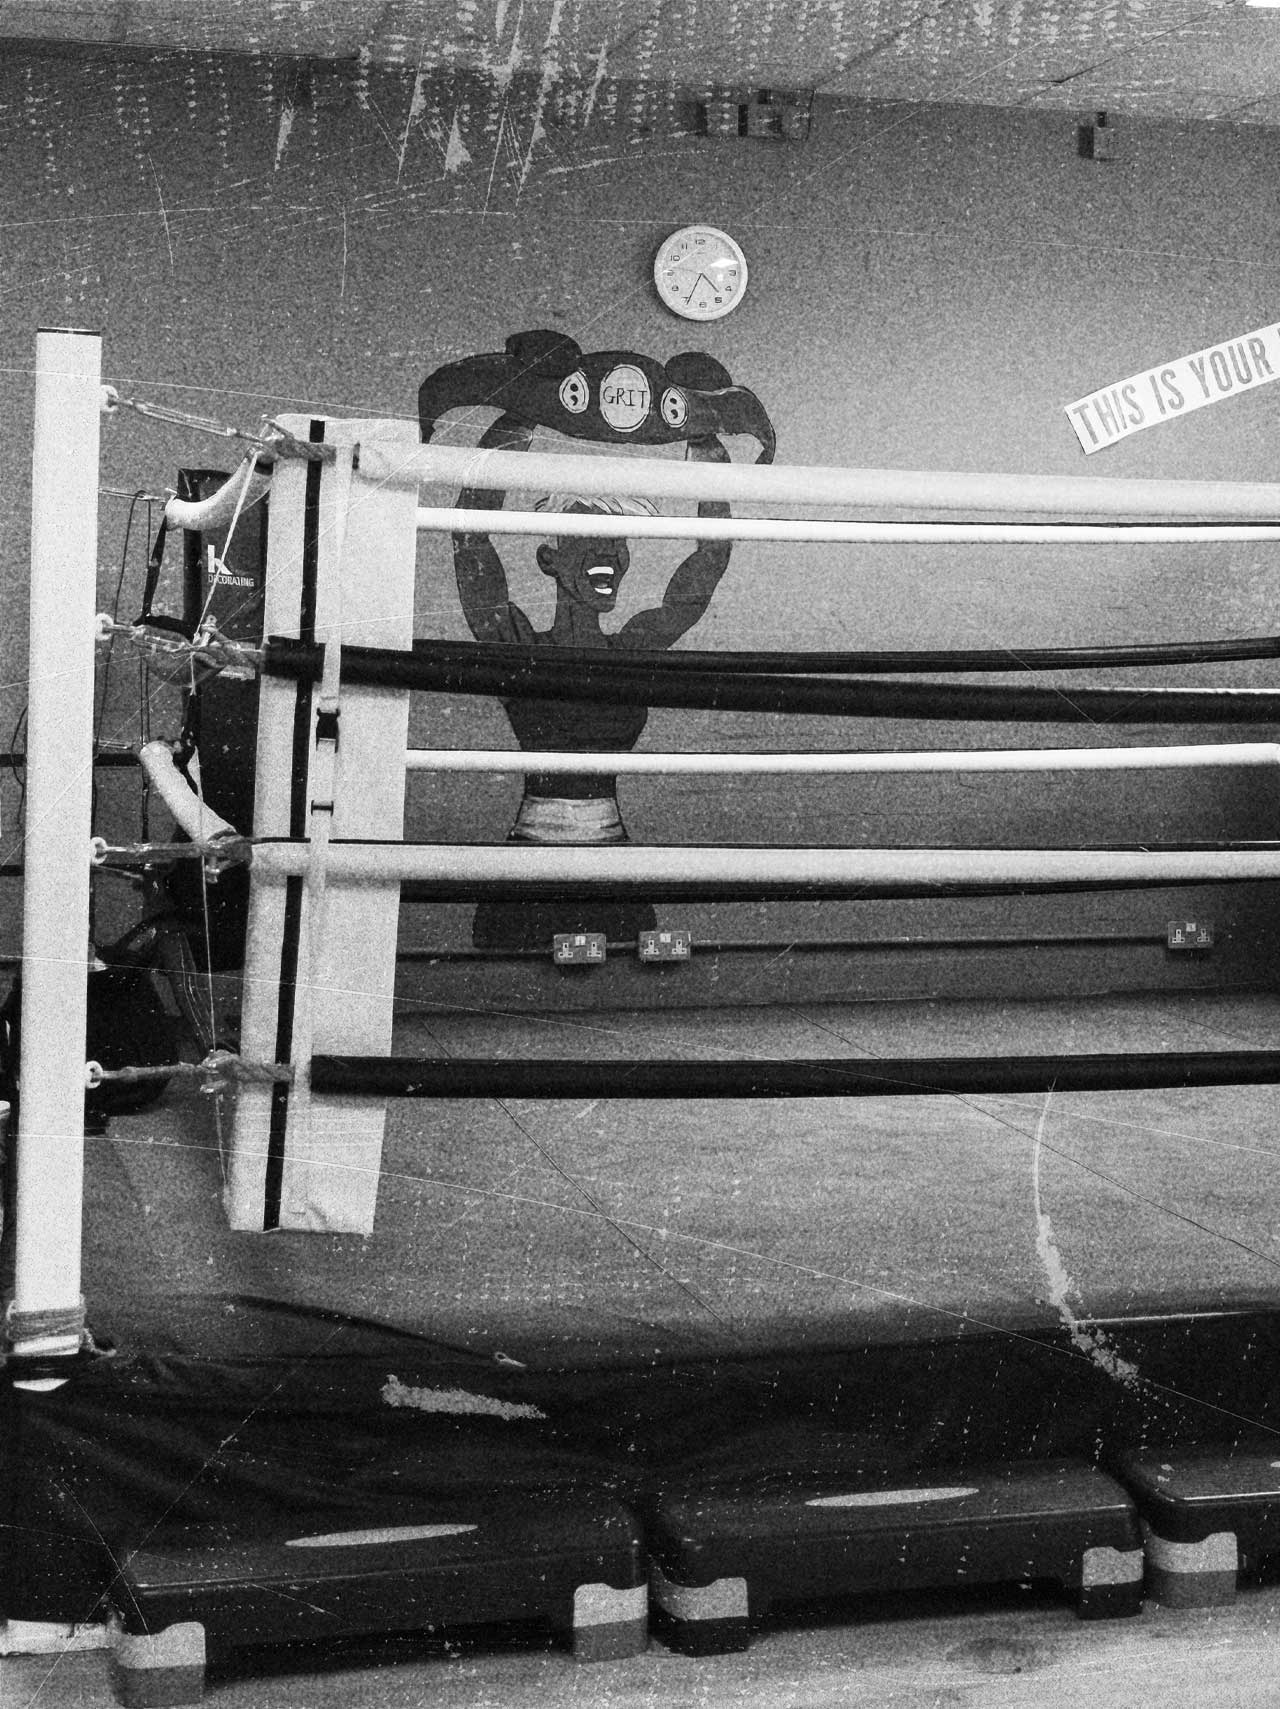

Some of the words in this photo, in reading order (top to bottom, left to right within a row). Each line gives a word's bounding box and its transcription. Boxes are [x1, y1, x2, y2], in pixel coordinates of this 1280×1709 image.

[602, 385, 648, 409] GRIT
[1072, 383, 1145, 445] THIS
[1149, 368, 1185, 415] IS
[1188, 336, 1274, 399] YOUR
